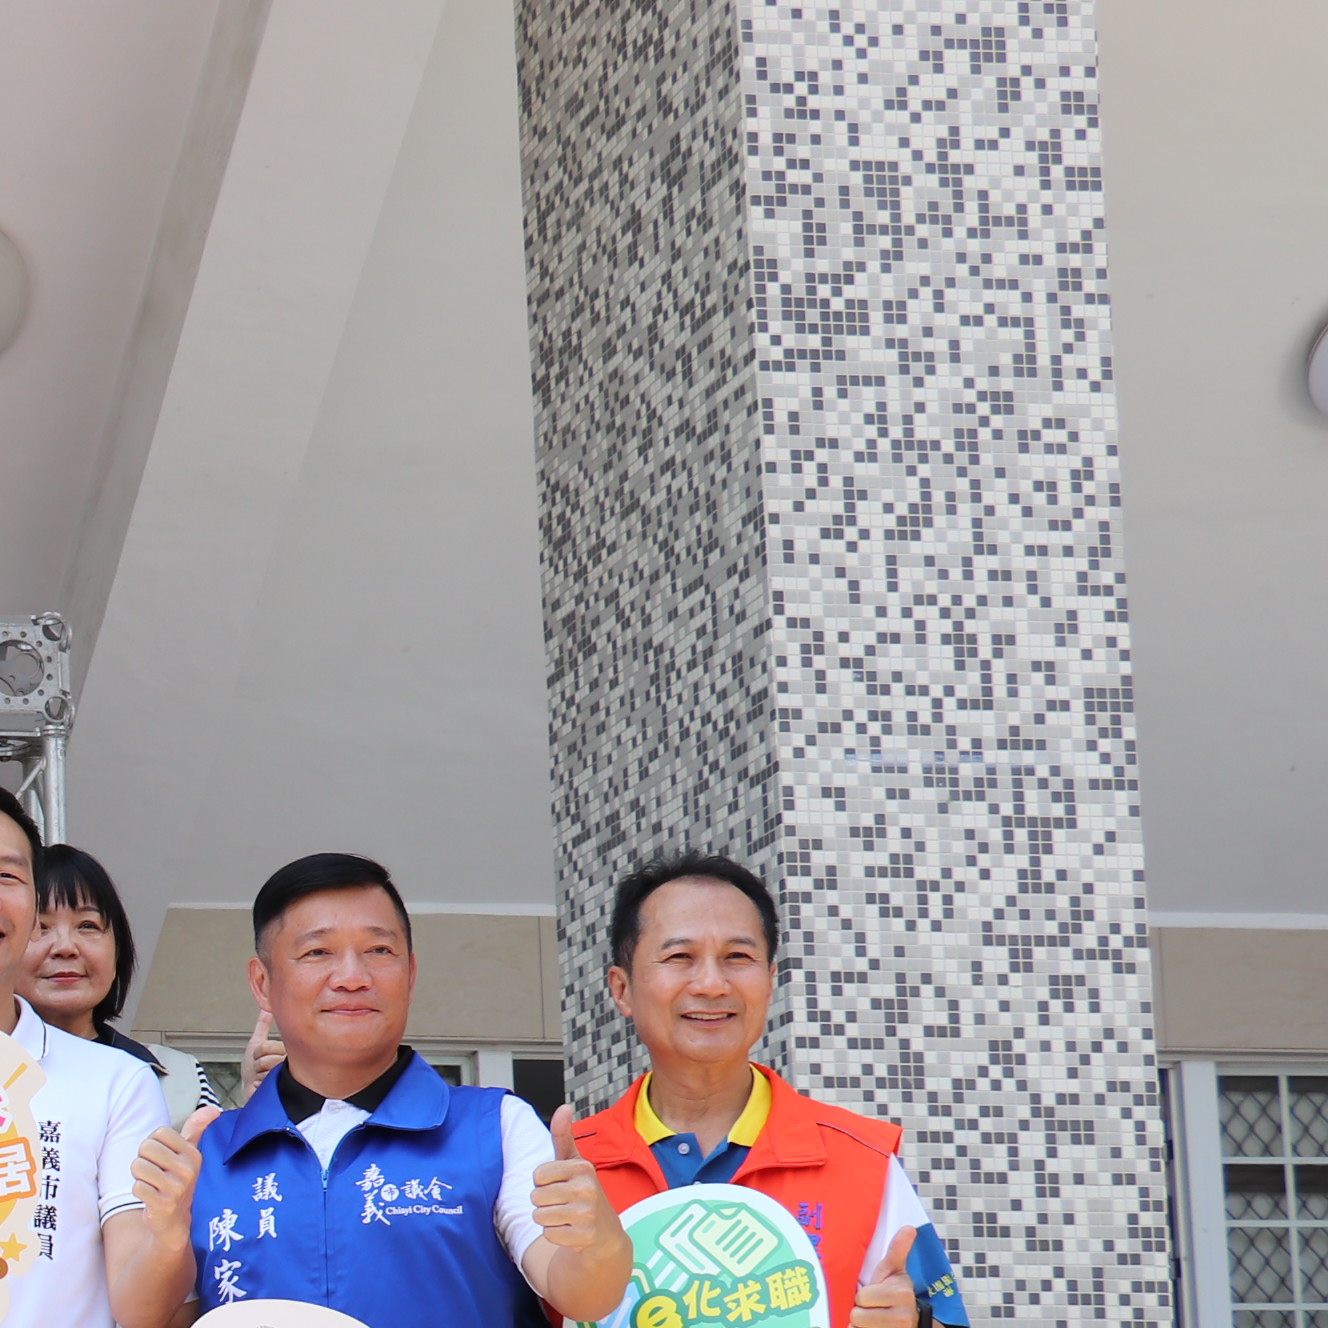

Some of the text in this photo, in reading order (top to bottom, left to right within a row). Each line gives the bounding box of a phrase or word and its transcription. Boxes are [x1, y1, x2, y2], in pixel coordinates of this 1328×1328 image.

[34, 1121, 62, 1261] 嘉義市議員
[251, 1172, 283, 1240] 議員
[355, 1163, 453, 1226] 嘉義市議會
[385, 1204, 464, 1217] Chiayi City Council
[208, 1208, 248, 1305] 陳家
